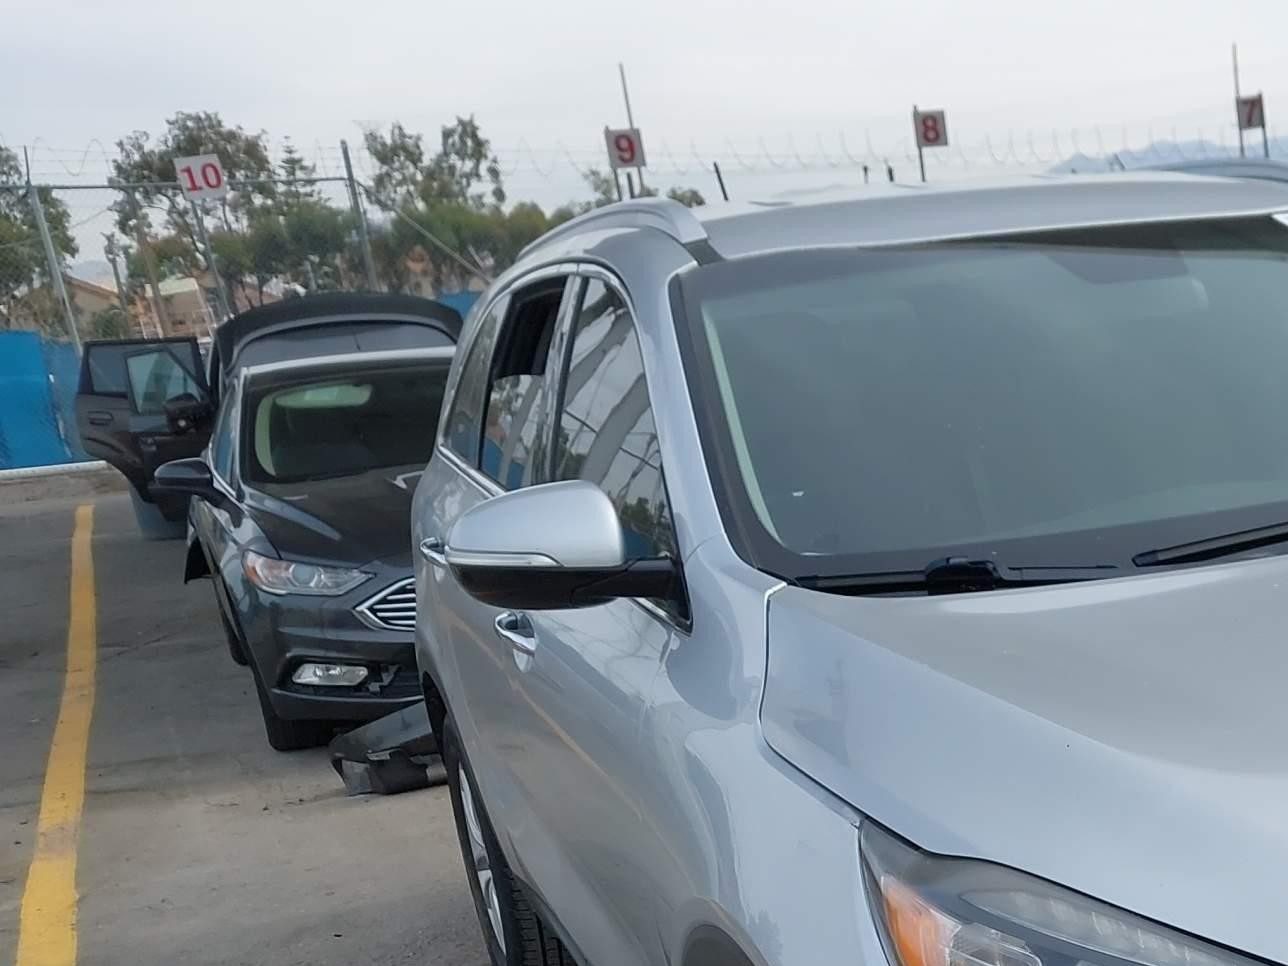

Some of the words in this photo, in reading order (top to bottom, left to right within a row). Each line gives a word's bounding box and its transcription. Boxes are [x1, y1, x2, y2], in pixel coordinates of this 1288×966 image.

[1242, 100, 1258, 126] 7
[922, 115, 940, 143] 8
[614, 134, 635, 164] 9
[180, 163, 221, 191] 10
